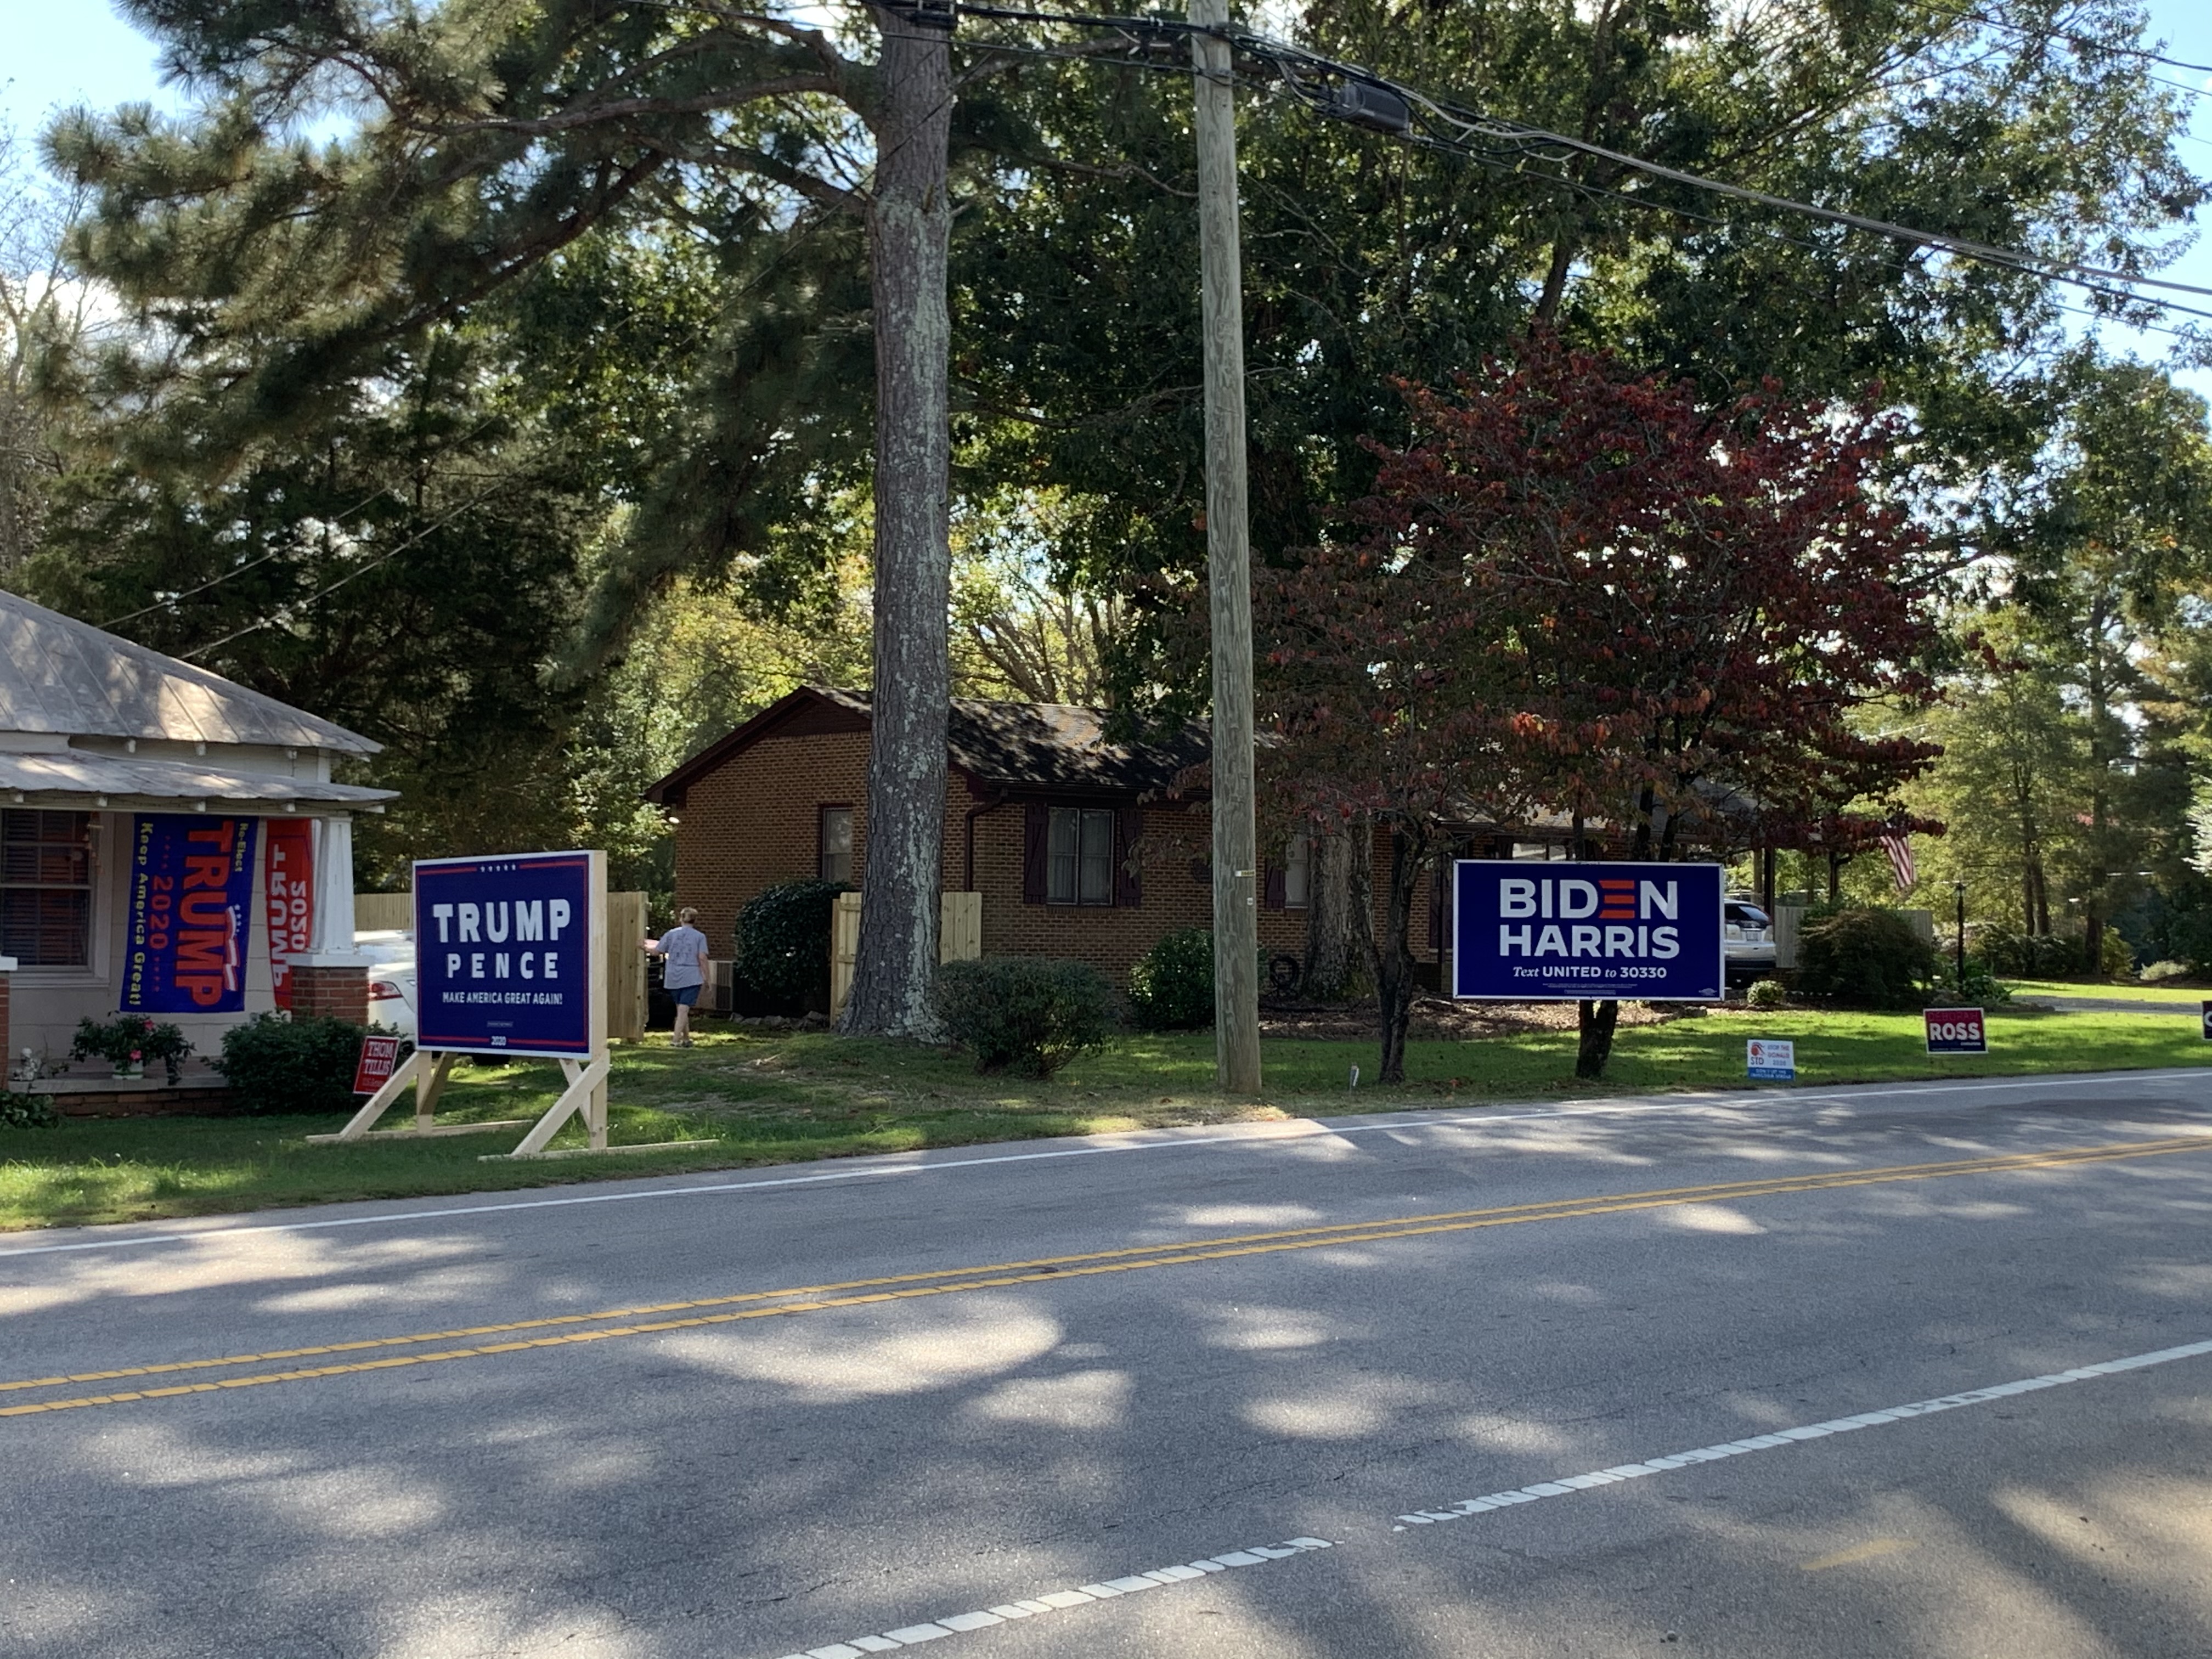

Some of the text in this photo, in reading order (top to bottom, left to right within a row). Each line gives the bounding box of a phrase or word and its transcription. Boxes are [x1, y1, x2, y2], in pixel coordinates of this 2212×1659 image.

[234, 822, 249, 872] Re-Elect
[129, 822, 154, 1005] Keep America Great!
[149, 875, 174, 950] 2020
[175, 820, 234, 1006] TRUMP
[1499, 878, 1678, 920] BIDEN
[433, 899, 571, 943] TRUMP
[1499, 924, 1680, 960] HARRIS
[447, 952, 558, 979] PENCE
[1513, 966, 1667, 979] Text UNITED to 30330
[442, 991, 563, 1005] MAKE AMERICA GREAT AGAIN!
[367, 1041, 394, 1058] THOM
[1929, 1022, 1980, 1041] ROSS
[364, 1059, 391, 1075] TILLIS
